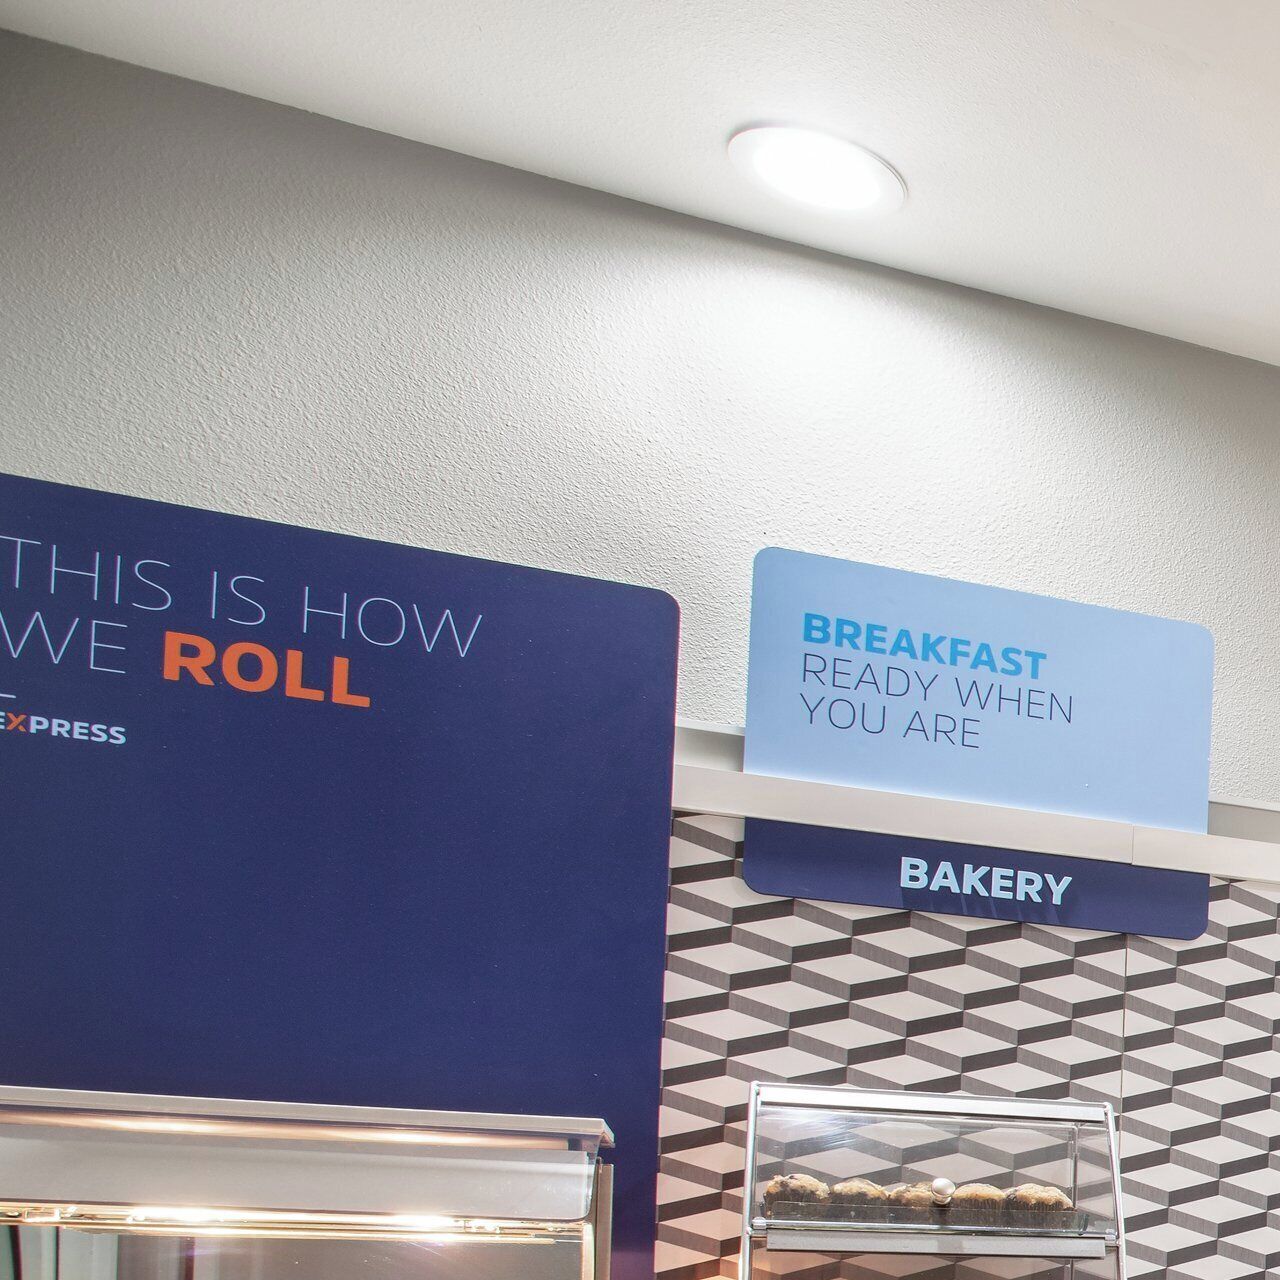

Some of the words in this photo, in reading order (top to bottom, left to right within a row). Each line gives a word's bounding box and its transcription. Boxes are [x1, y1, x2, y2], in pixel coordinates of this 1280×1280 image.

[0, 534, 172, 611] THIS
[210, 570, 266, 626] IS
[302, 586, 483, 658] HOW
[0, 610, 128, 674] WE
[163, 630, 371, 708] ROLL
[802, 612, 1047, 680] BREAKFAST
[800, 692, 886, 734] YOU
[902, 710, 981, 749] ARE
[802, 653, 939, 702] READY
[954, 677, 1073, 724] WHEN
[0, 711, 127, 745] EXPRESS
[899, 856, 1073, 906] BAKERY
